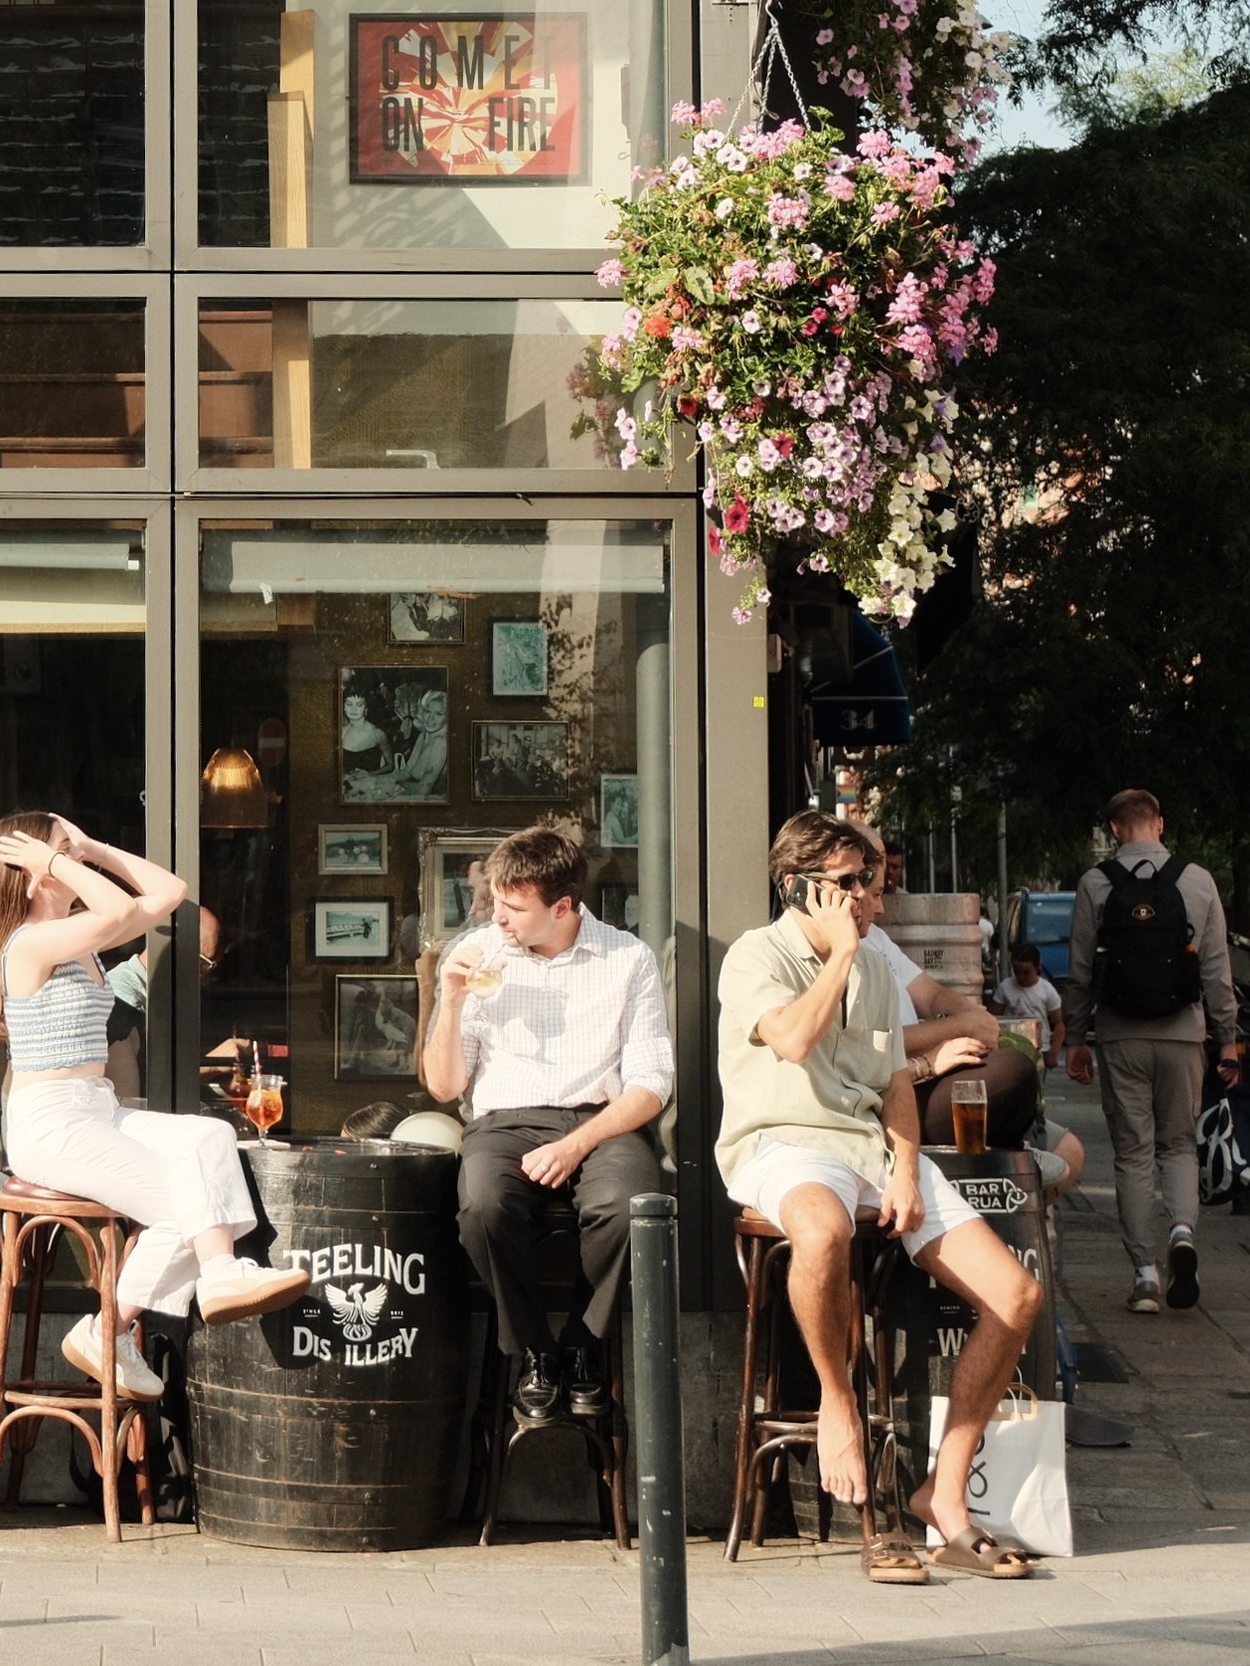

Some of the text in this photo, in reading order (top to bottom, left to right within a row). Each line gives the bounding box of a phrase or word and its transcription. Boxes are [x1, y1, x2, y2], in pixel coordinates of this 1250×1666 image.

[382, 34, 556, 90] COMET
[382, 97, 555, 151] ON FIRE
[840, 709, 875, 731] 34
[965, 1184, 1000, 1196] BAR
[969, 1196, 1002, 1209] RUA
[283, 1243, 426, 1295] TEELING
[293, 1325, 419, 1366] DISILLERY
